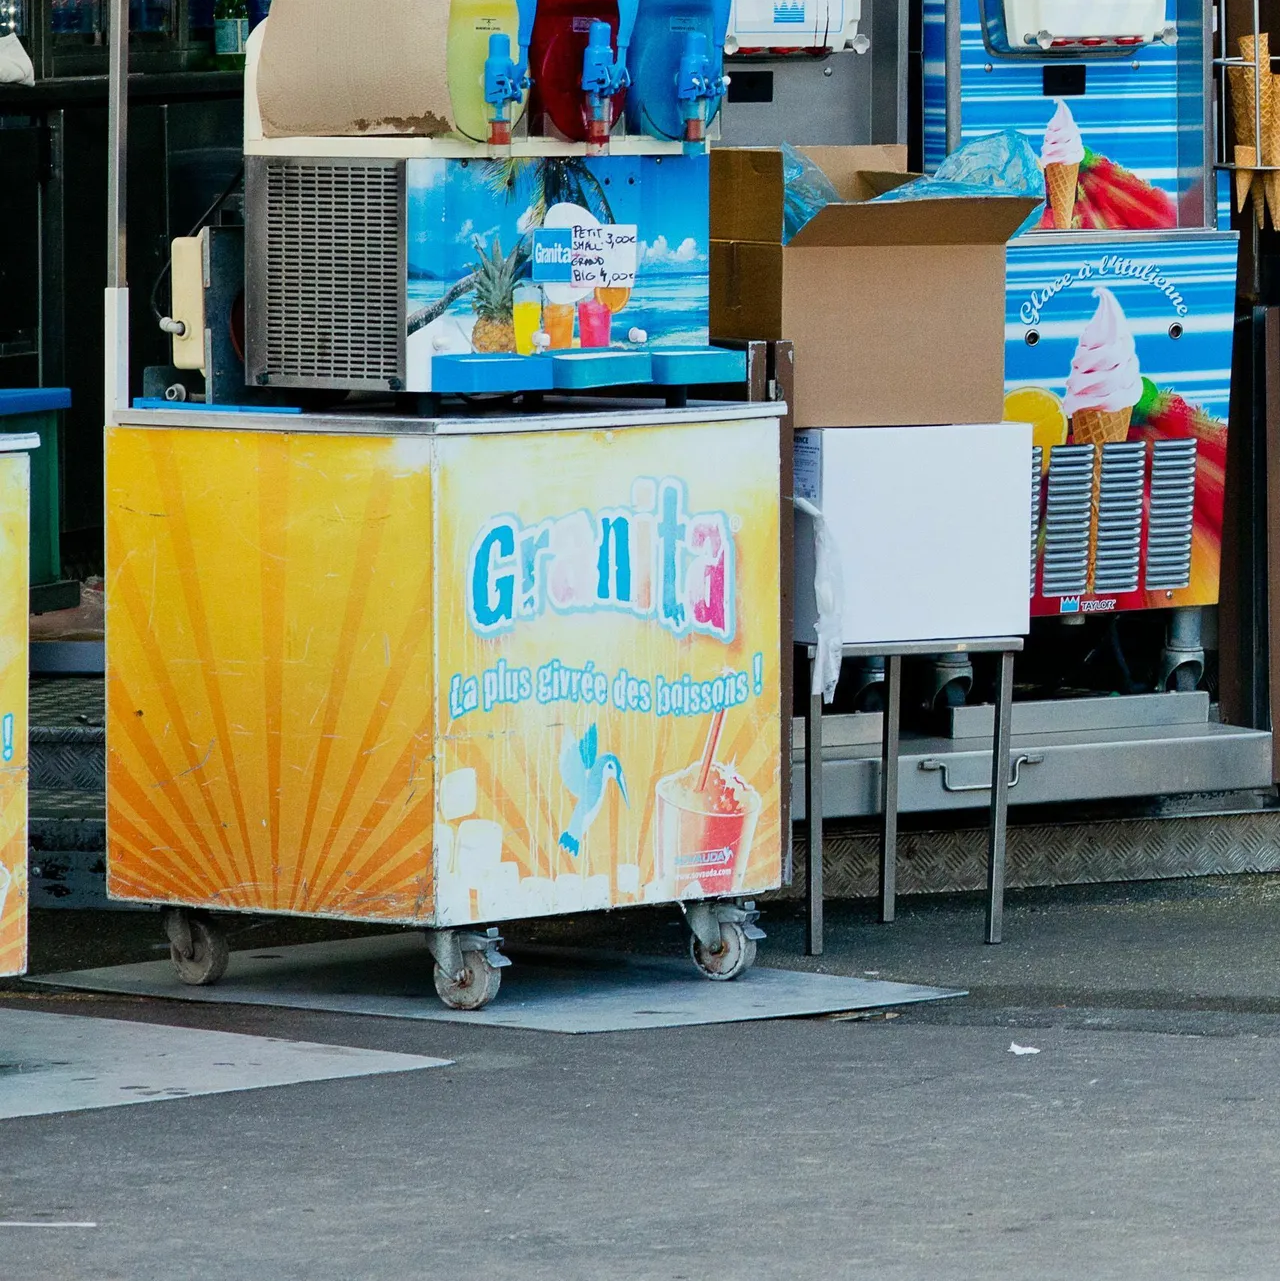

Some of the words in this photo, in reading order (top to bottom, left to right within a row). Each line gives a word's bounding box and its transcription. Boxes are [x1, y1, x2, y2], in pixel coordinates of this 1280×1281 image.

[572, 225, 603, 238] PETIT
[605, 233, 637, 249] 3,00€
[572, 241, 603, 251] SMALL
[535, 242, 571, 264] Granita
[571, 257, 605, 267] GRAND
[573, 269, 596, 282] BIG
[600, 267, 634, 288] 4,00€
[1019, 273, 1075, 325] Glace
[1078, 262, 1093, 280] à
[1098, 254, 1189, 317] l'italienne
[468, 475, 736, 644] Granita
[1081, 599, 1117, 612] TAYLOR
[450, 673, 480, 720] La
[482, 659, 533, 712] plus
[536, 659, 609, 704] givrée
[612, 668, 652, 714] des
[655, 670, 750, 717] boissons
[753, 652, 764, 695] !
[3, 712, 14, 761] !
